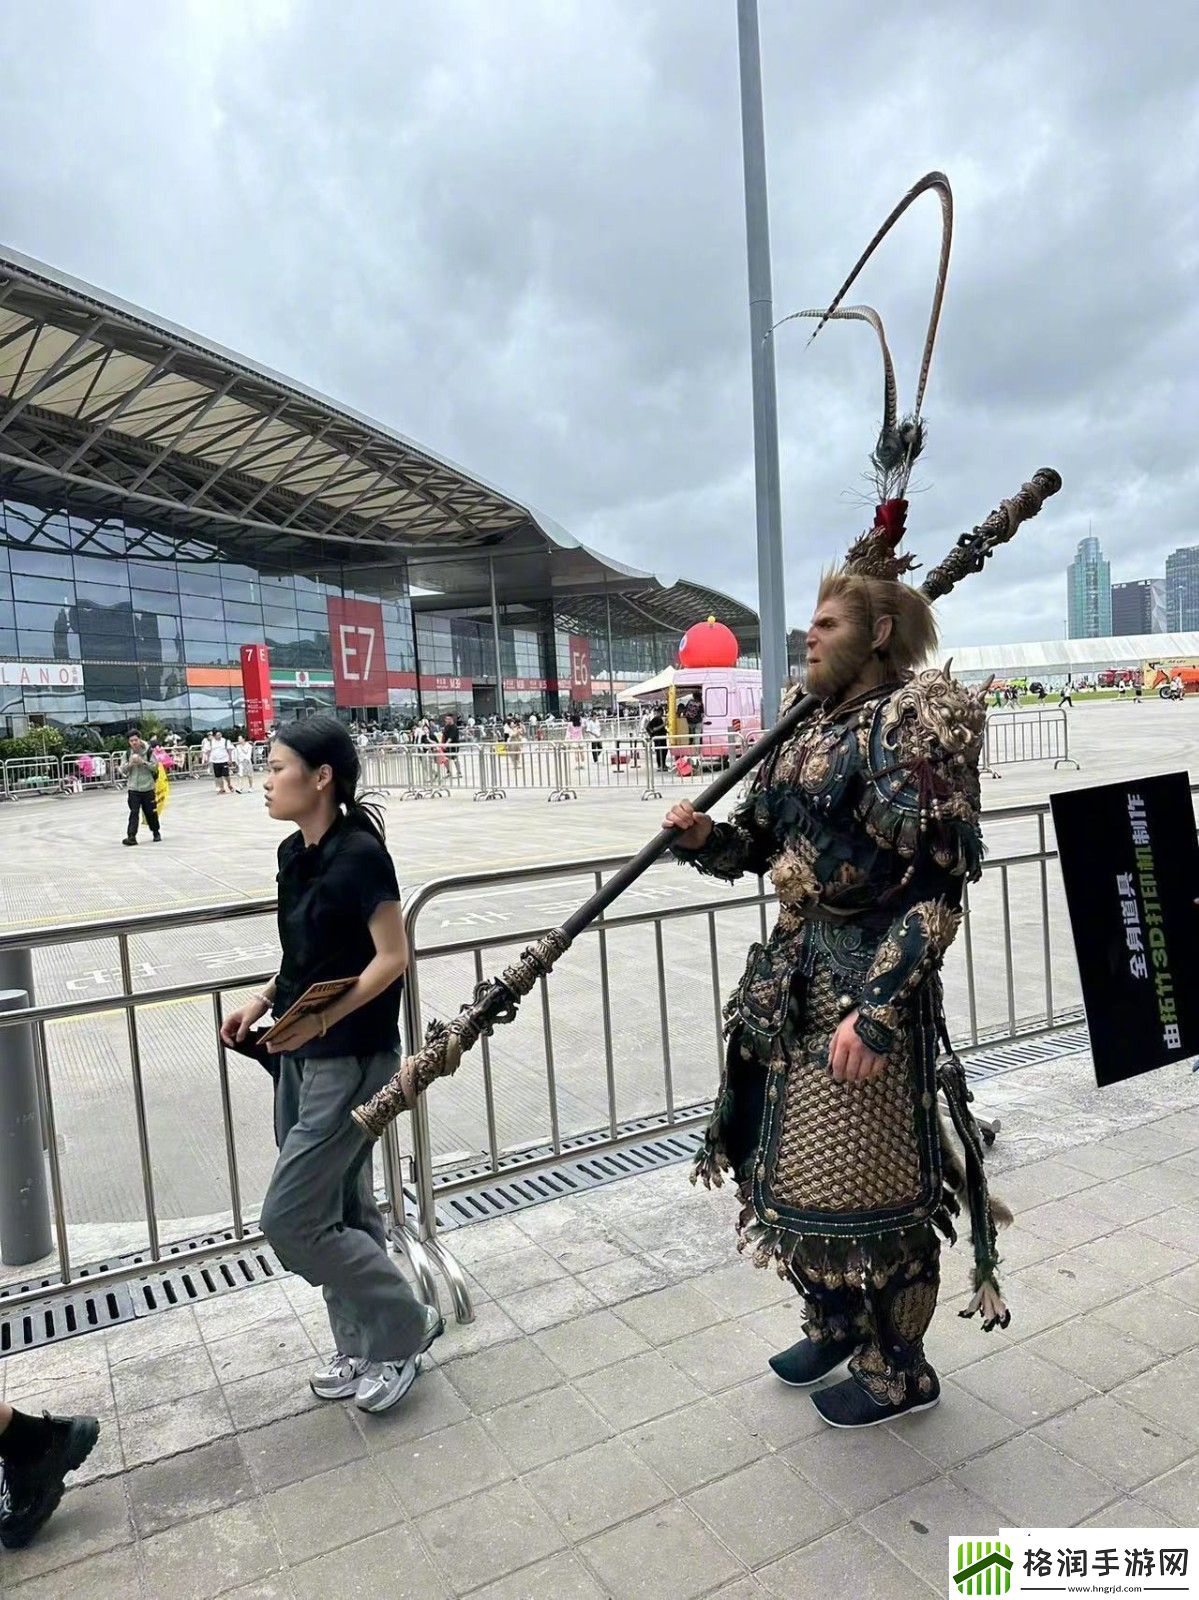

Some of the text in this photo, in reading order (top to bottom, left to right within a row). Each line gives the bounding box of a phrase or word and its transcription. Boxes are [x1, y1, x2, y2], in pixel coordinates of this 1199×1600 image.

[1, 667, 69, 684] LANO
[245, 648, 253, 662] 7
[339, 624, 375, 681] E7
[573, 651, 588, 686] E6
[1116, 871, 1148, 980] 全身道具
[1127, 793, 1182, 1050] 由拓竹3D打印机制作
